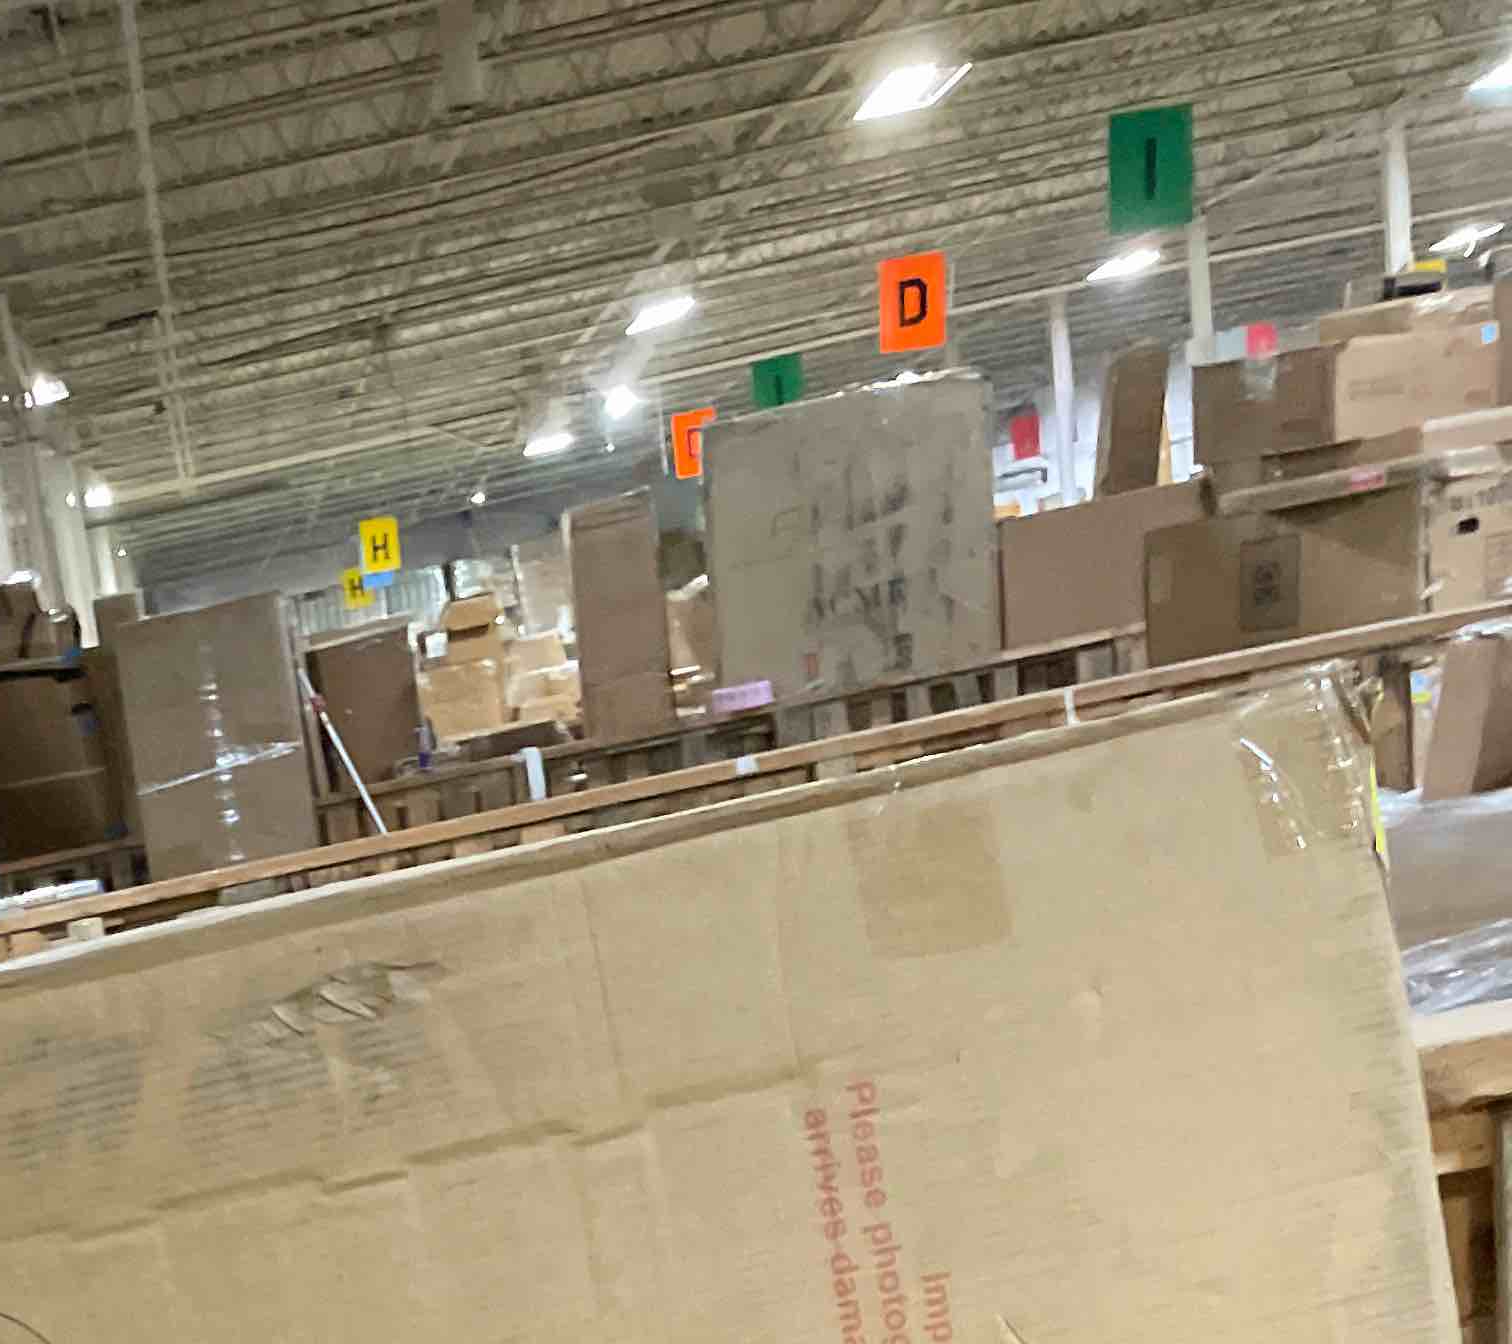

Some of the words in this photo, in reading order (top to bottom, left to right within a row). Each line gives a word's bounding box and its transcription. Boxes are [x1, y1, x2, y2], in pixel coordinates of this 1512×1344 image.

[898, 278, 928, 328] D
[371, 533, 391, 562] H
[803, 1109, 847, 1240] arrives
[845, 1080, 888, 1209] Please
